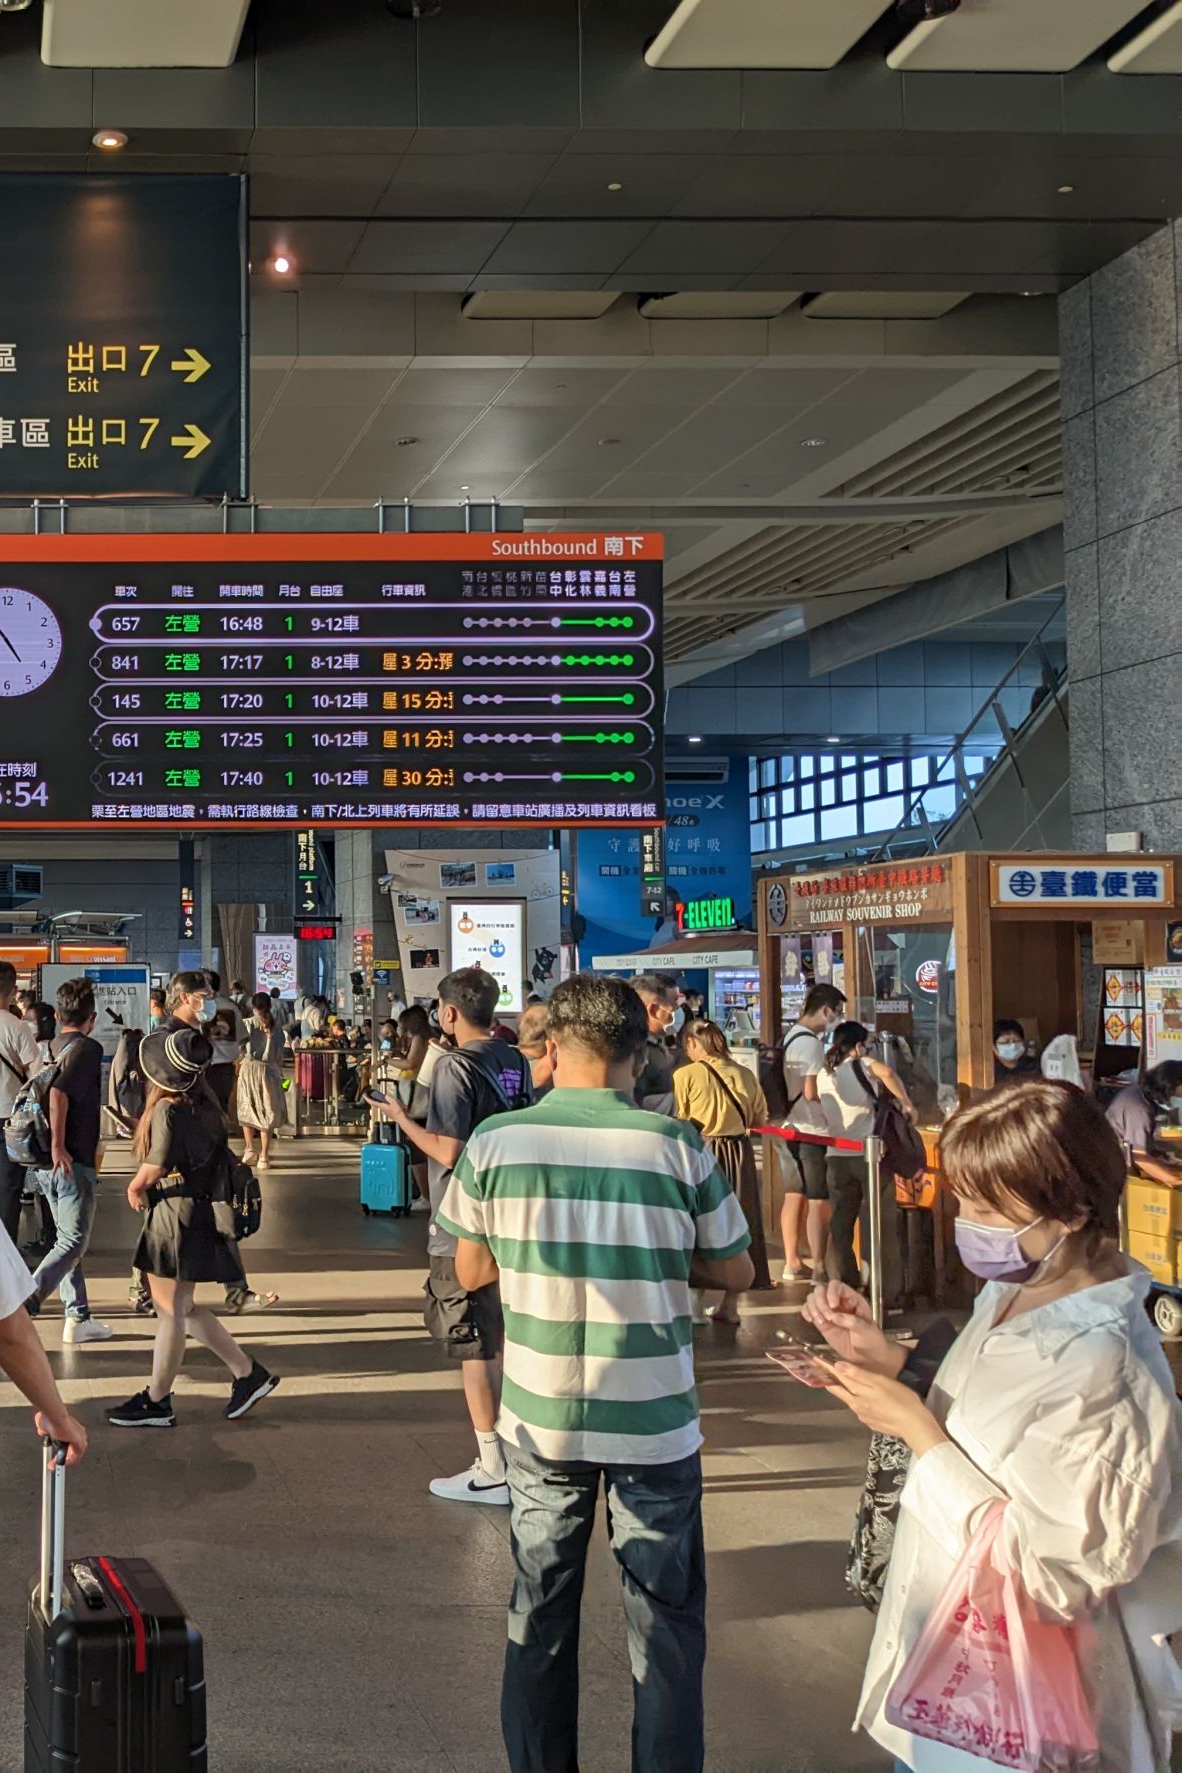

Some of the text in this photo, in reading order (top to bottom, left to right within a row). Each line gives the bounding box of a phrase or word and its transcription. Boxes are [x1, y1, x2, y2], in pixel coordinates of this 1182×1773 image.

[67, 342, 160, 376] 出口 7
[68, 377, 99, 393] Exit
[67, 415, 160, 450] 出口 7
[68, 453, 99, 469] Exit
[492, 537, 644, 556] Southbound 南下
[114, 585, 137, 597] 車次
[278, 585, 301, 597] 月台
[310, 585, 344, 597] 自由座
[382, 584, 426, 597] 行車資訊
[2, 596, 14, 606] 12
[26, 602, 32, 611] 1
[40, 617, 48, 627] 2
[112, 614, 360, 633] 657 左營 16:48 1 9-12車
[46, 639, 54, 648] 3
[39, 660, 47, 670] 4
[111, 653, 411, 672] 841 左營 17:17 1 8-12車 3
[3, 680, 11, 690] 6
[25, 675, 32, 685] 5
[112, 692, 421, 710] 145 左營 17:20 1 10-12車 15
[112, 730, 420, 749] 661 左營 17:25 1 10-12車 11
[107, 769, 421, 787] 1241 左營 17:40 1 10-12車 30
[304, 880, 313, 894] 1
[646, 886, 662, 894] 7-12
[1039, 870, 1159, 898] 臺鐵便當
[810, 902, 922, 924] RAILWAY SOUVENIR SHOP
[692, 955, 704, 965] CITY
